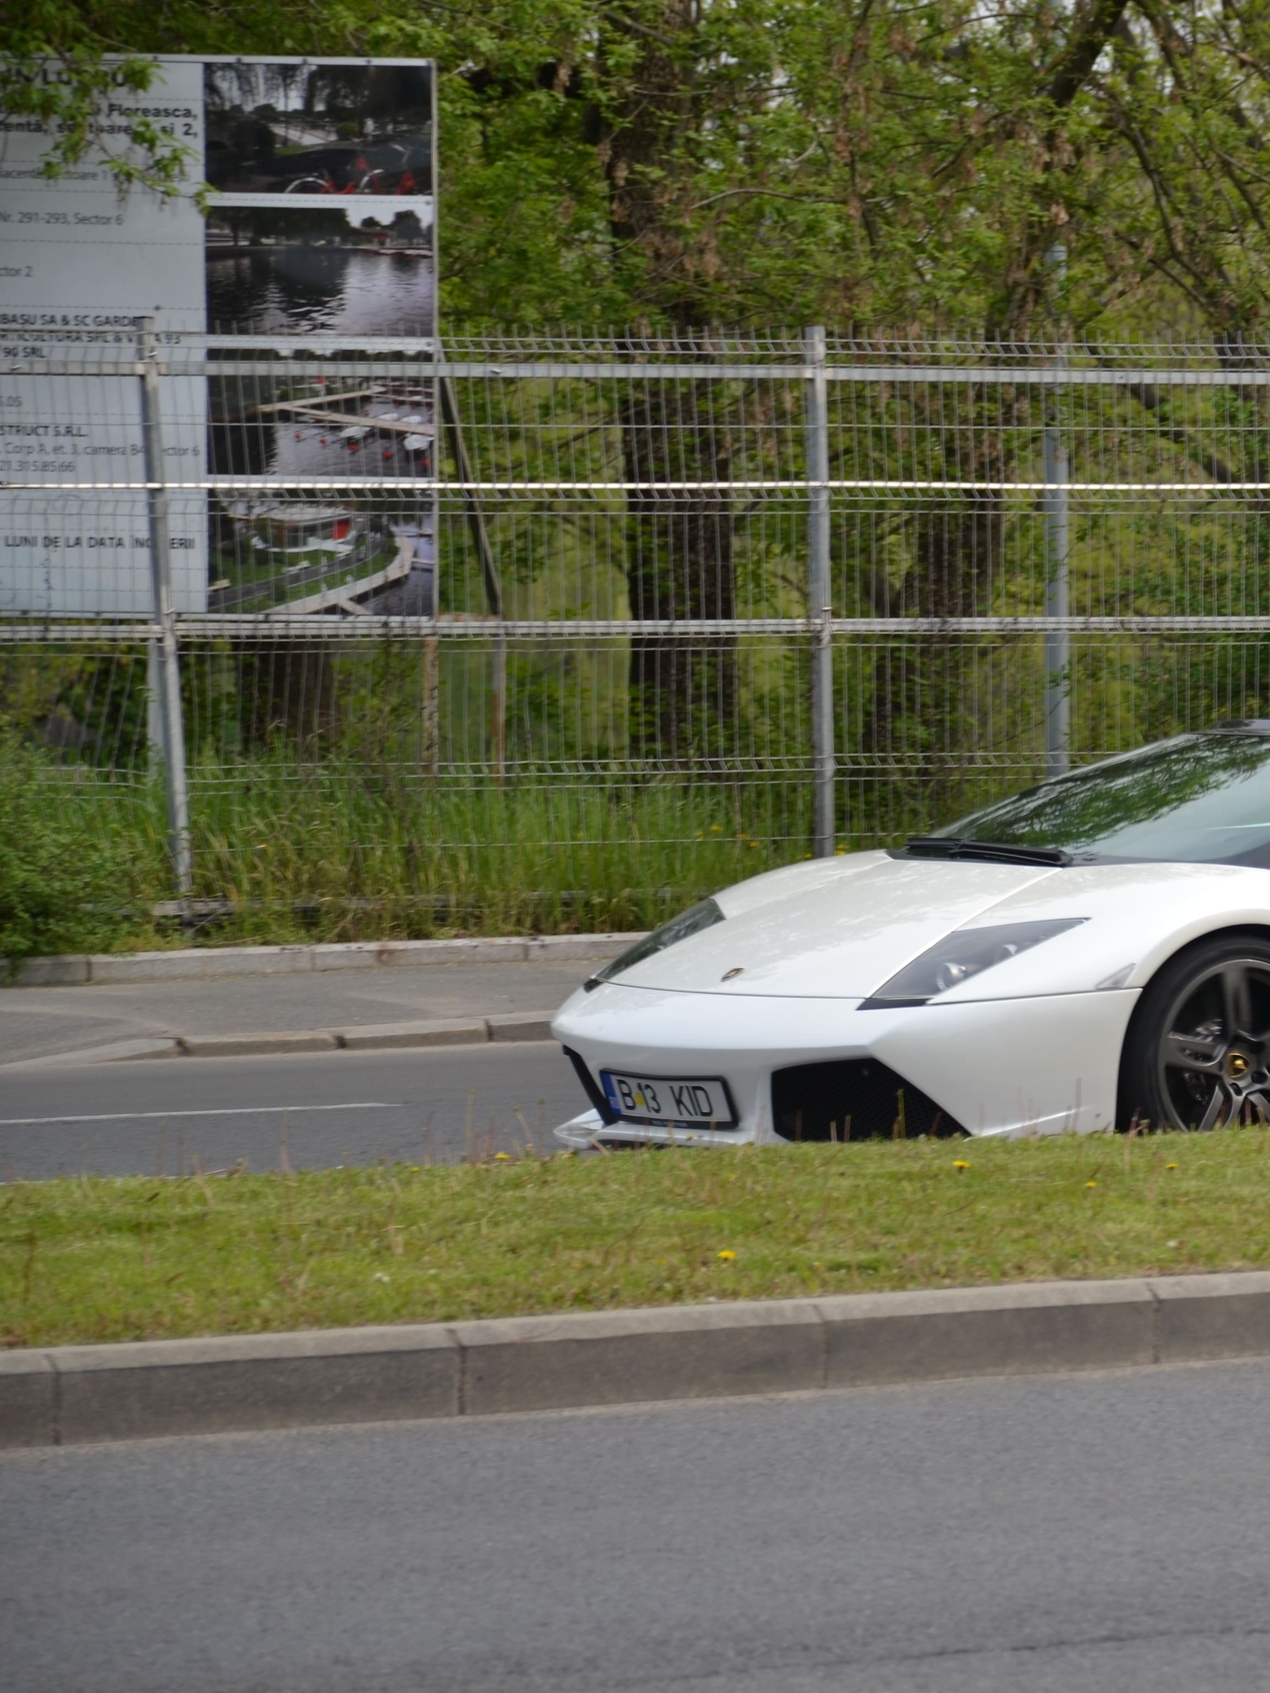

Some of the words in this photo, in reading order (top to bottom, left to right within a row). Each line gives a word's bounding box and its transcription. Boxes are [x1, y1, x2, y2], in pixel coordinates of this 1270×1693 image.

[107, 103, 197, 120] Floreasca,
[18, 212, 71, 225] 291-293,
[74, 213, 113, 226] Sector
[115, 214, 124, 226] 6
[24, 265, 34, 278] 2
[40, 314, 58, 326] SA
[74, 315, 90, 327] SC
[22, 347, 46, 359] SRL
[84, 446, 127, 457] camera
[4, 535, 38, 548] LUNI
[43, 536, 62, 548] DE
[66, 536, 83, 549] LA
[88, 537, 125, 549] DATA
[669, 1085, 714, 1117] KID
